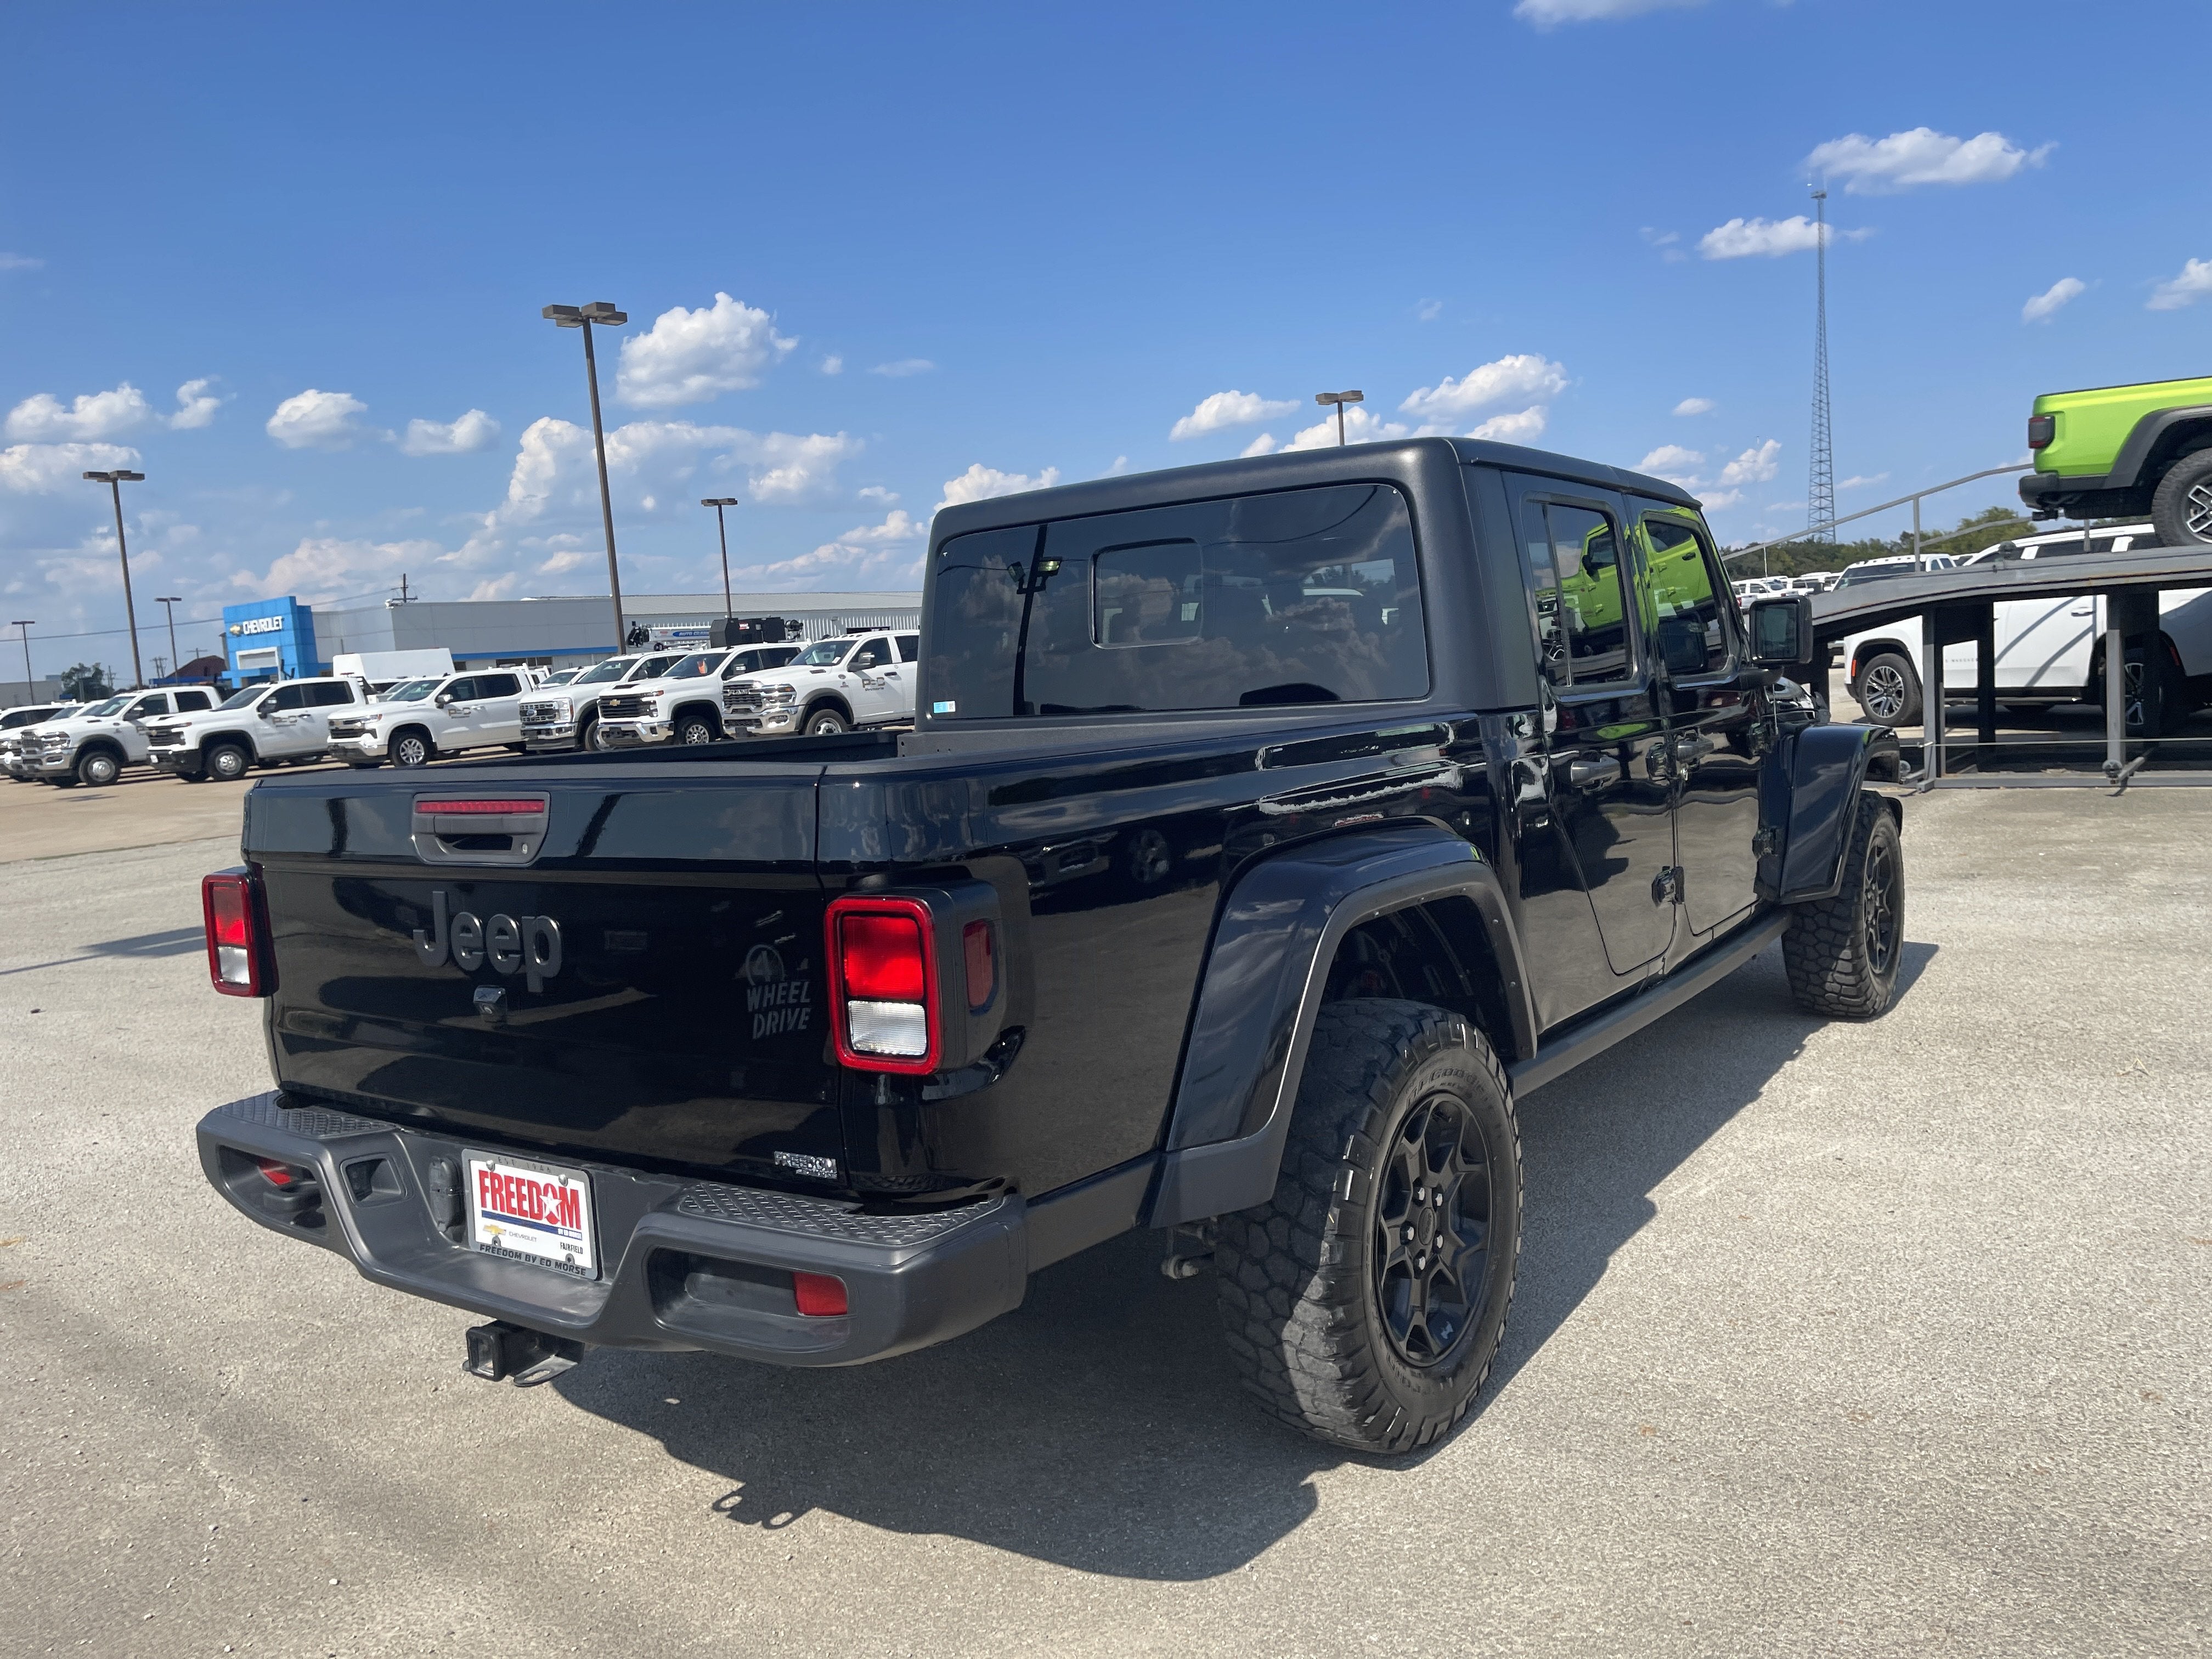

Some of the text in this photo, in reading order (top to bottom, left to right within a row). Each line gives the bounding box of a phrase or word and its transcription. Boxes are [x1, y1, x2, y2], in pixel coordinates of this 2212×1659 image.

[243, 616, 283, 635] CHEVROLET
[413, 890, 563, 993] Jeep
[747, 981, 811, 1012] WHEEL
[753, 1007, 813, 1040] DRIVE
[478, 1169, 582, 1231] FREEDOM
[509, 1231, 537, 1243] CHEVROLET
[560, 1242, 583, 1255] FAIRFIELD
[479, 1243, 587, 1277] FREEDOM BY ED MORSE
